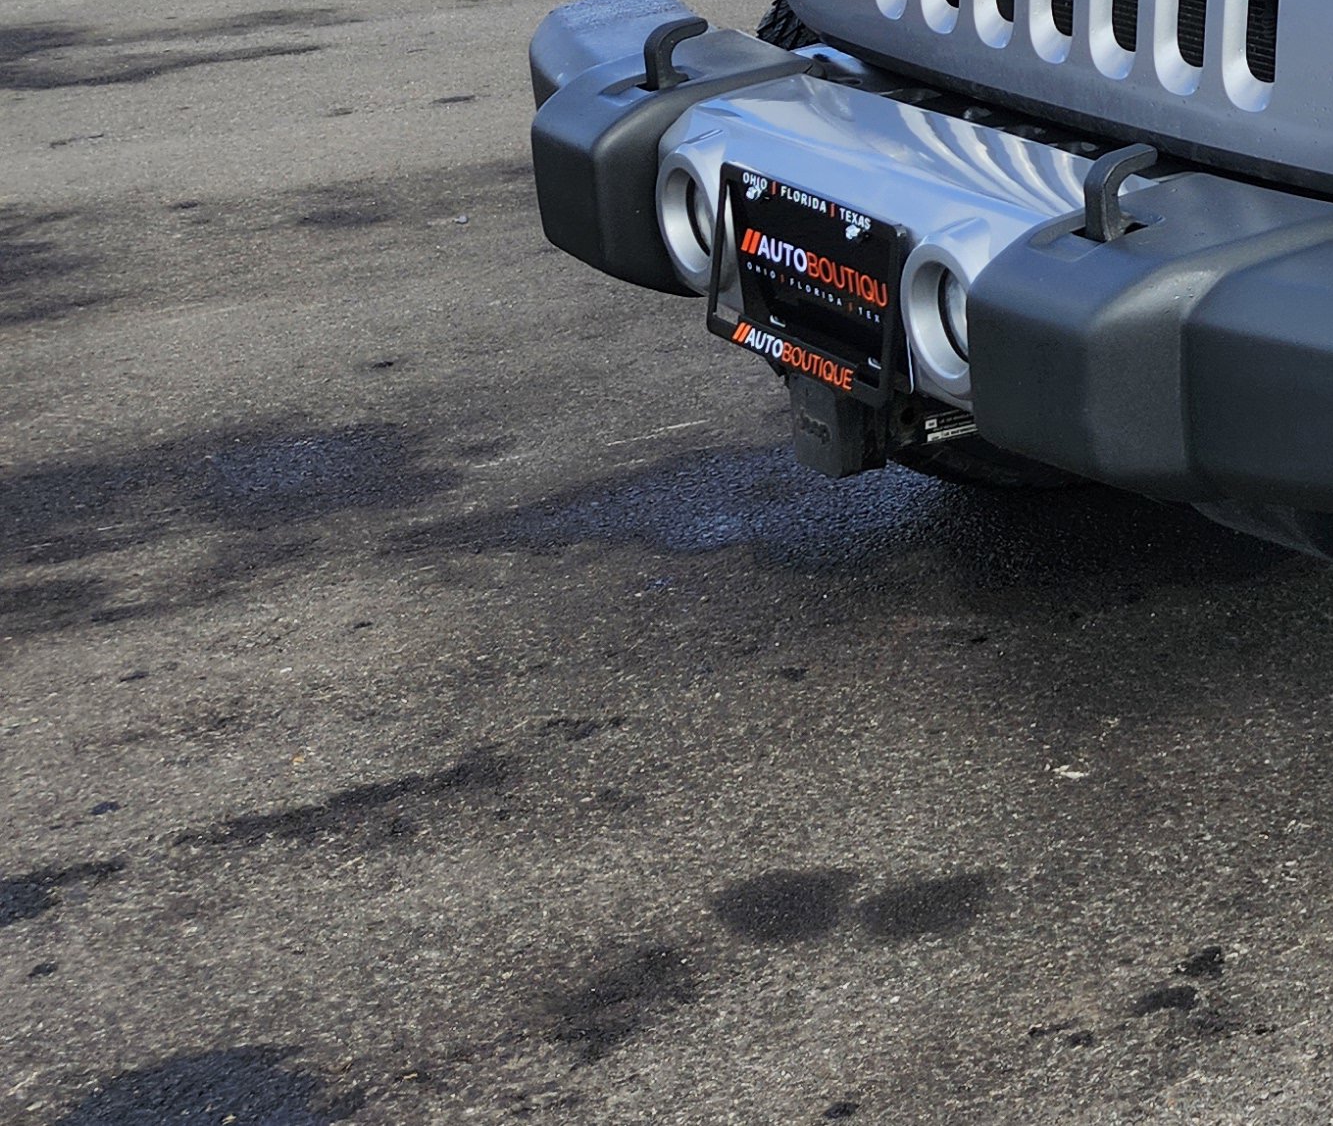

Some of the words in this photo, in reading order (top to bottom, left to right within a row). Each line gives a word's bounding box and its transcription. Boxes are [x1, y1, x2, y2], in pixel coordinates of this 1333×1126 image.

[742, 172, 768, 190] OHIO
[780, 185, 827, 214] FLORIDA
[839, 208, 872, 230] TEXAS
[746, 261, 776, 280] OHIO
[789, 277, 842, 306] FLORIDA
[747, 327, 854, 391] AUTOBOUTIQUE
